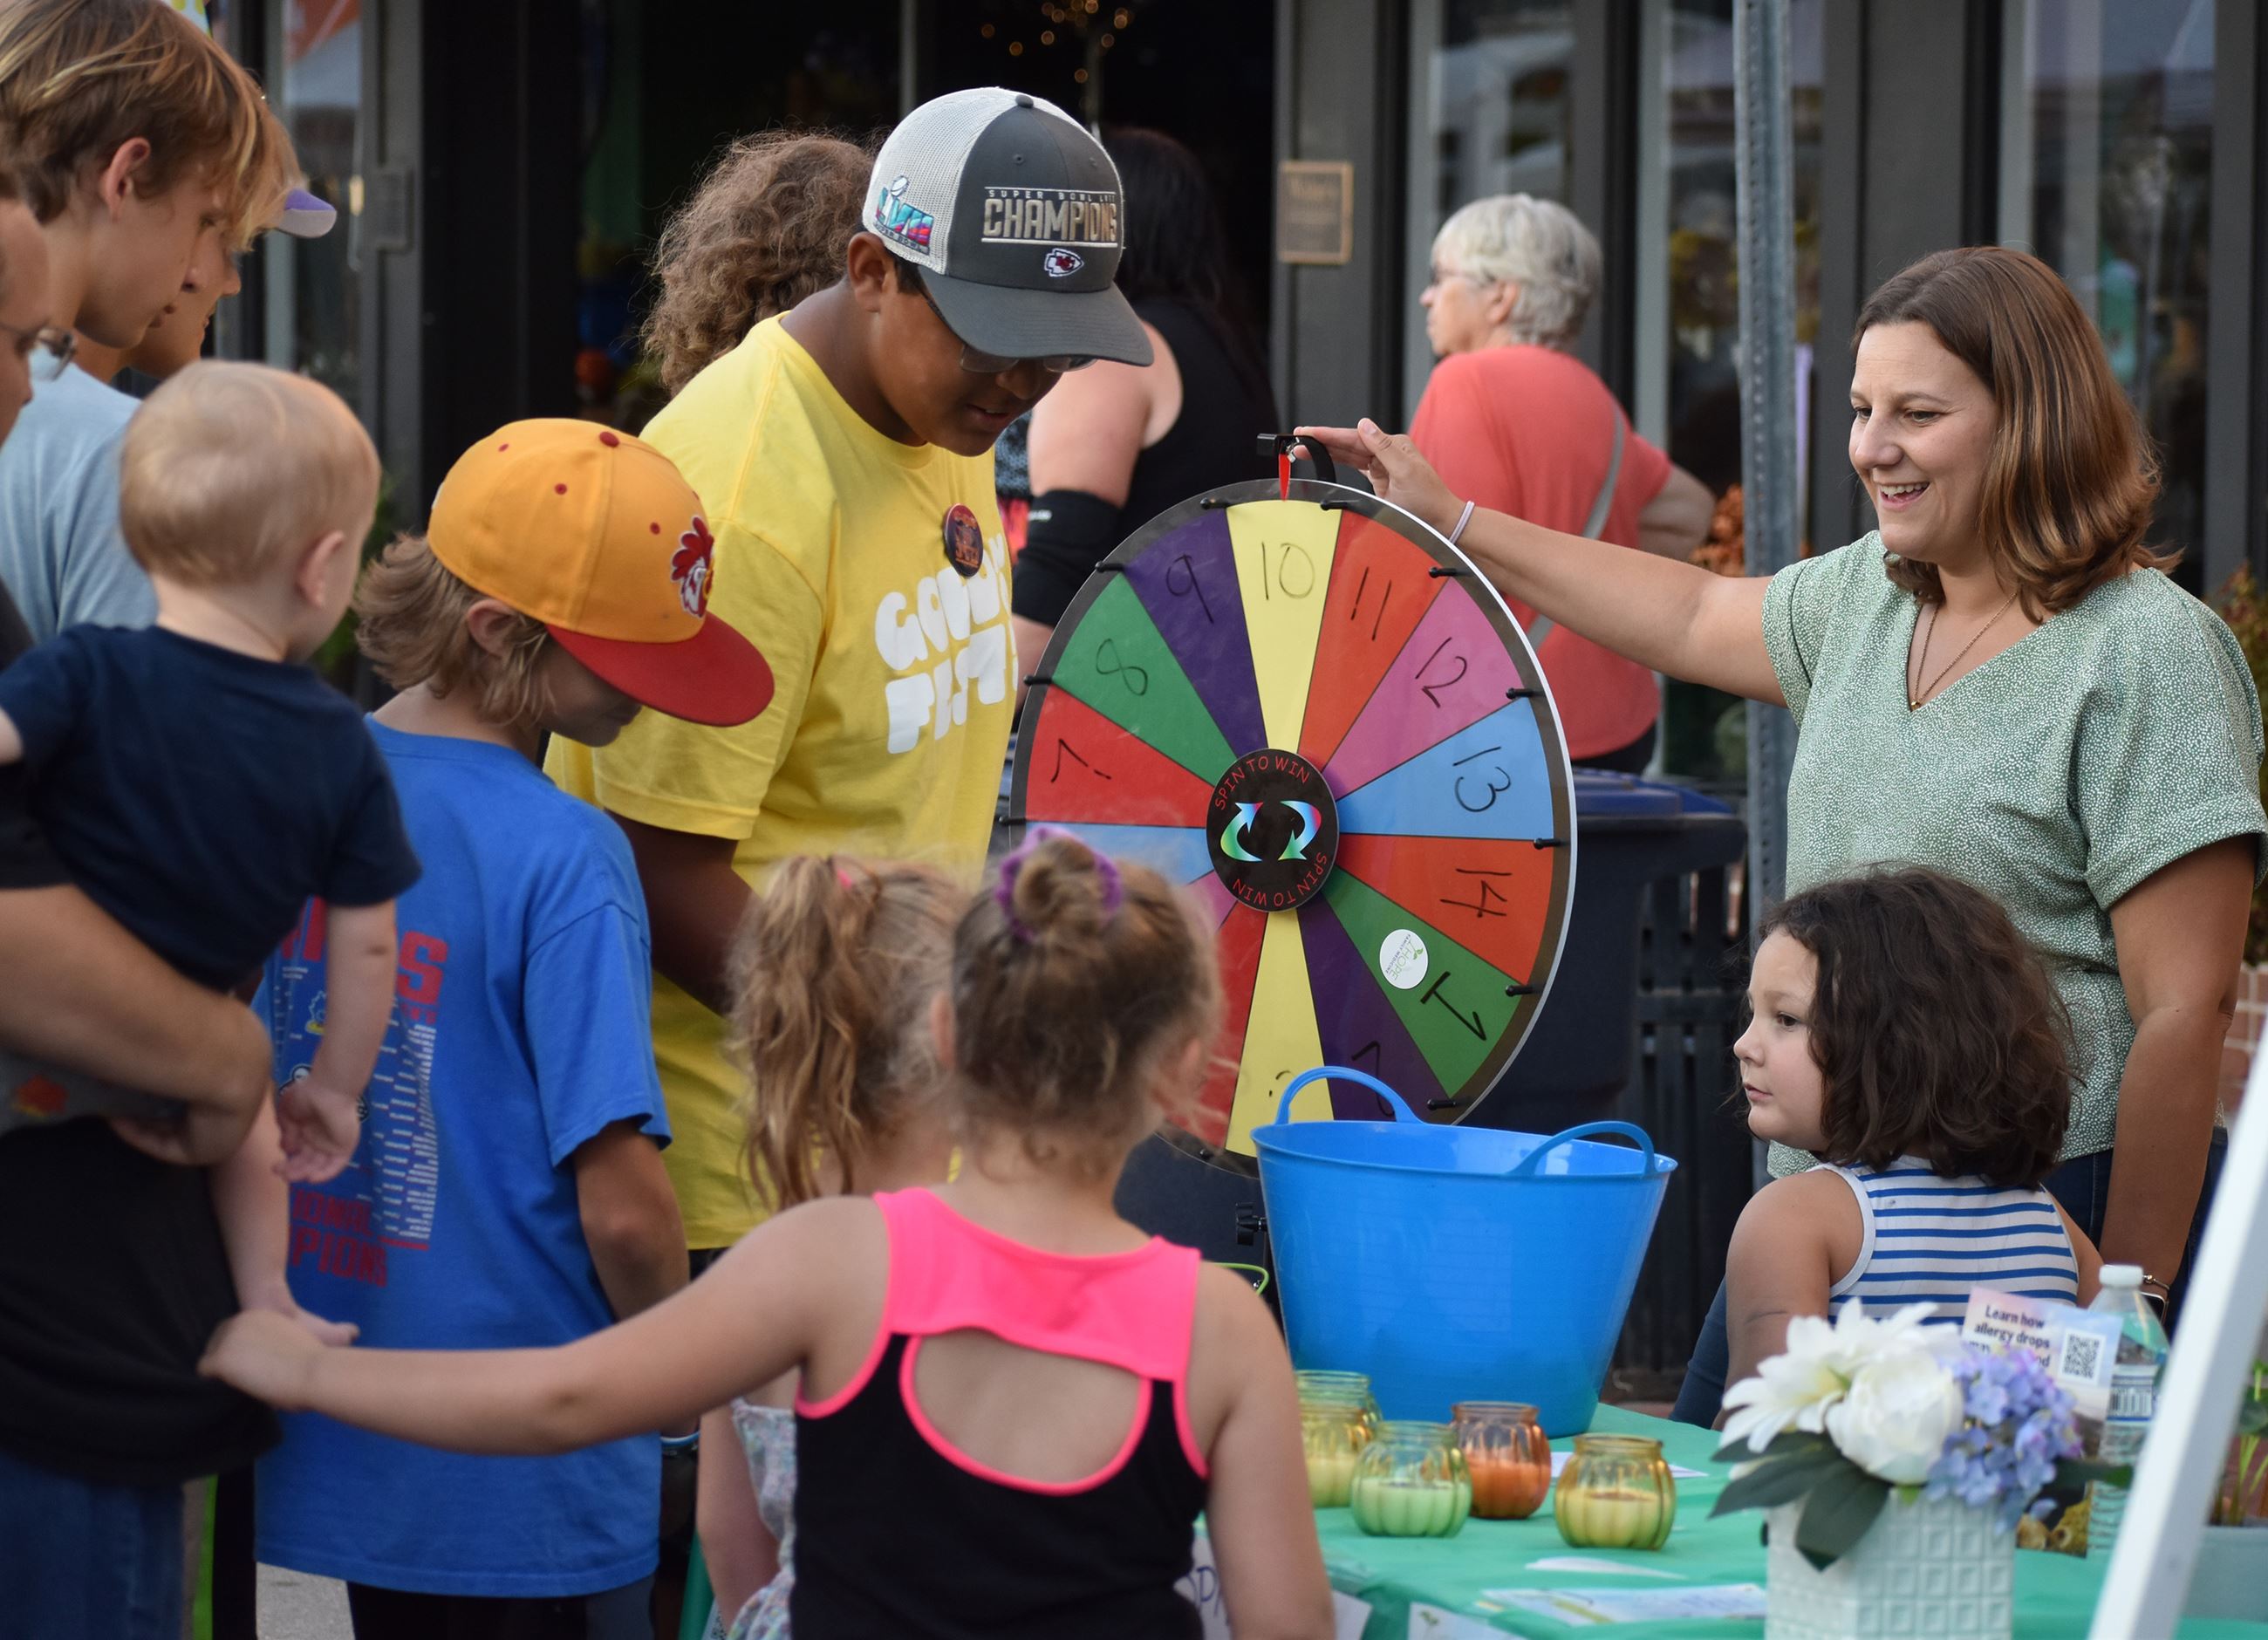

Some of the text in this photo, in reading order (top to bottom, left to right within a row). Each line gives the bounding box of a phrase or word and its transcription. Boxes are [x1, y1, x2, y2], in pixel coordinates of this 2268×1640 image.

[983, 198, 1117, 242] CHAMPIONS
[988, 189, 1044, 200] SUPER
[1058, 191, 1092, 202] BOWL
[1166, 554, 1214, 625] 9
[1261, 542, 1315, 601] 10
[1350, 566, 1392, 641] 11
[1096, 638, 1149, 696] 8
[1415, 637, 1468, 709] 12
[1050, 738, 1112, 783] 7
[1214, 755, 1310, 810] SPIN TO WIN
[1452, 746, 1512, 813] 13
[1233, 851, 1328, 907] SPIN TO WIN
[1440, 868, 1513, 918] 14
[1420, 971, 1486, 1041] 1
[290, 1226, 388, 1288] PIONS
[1974, 1322, 2050, 1349] allergy drops
[1985, 1305, 2045, 1329] Learn how
